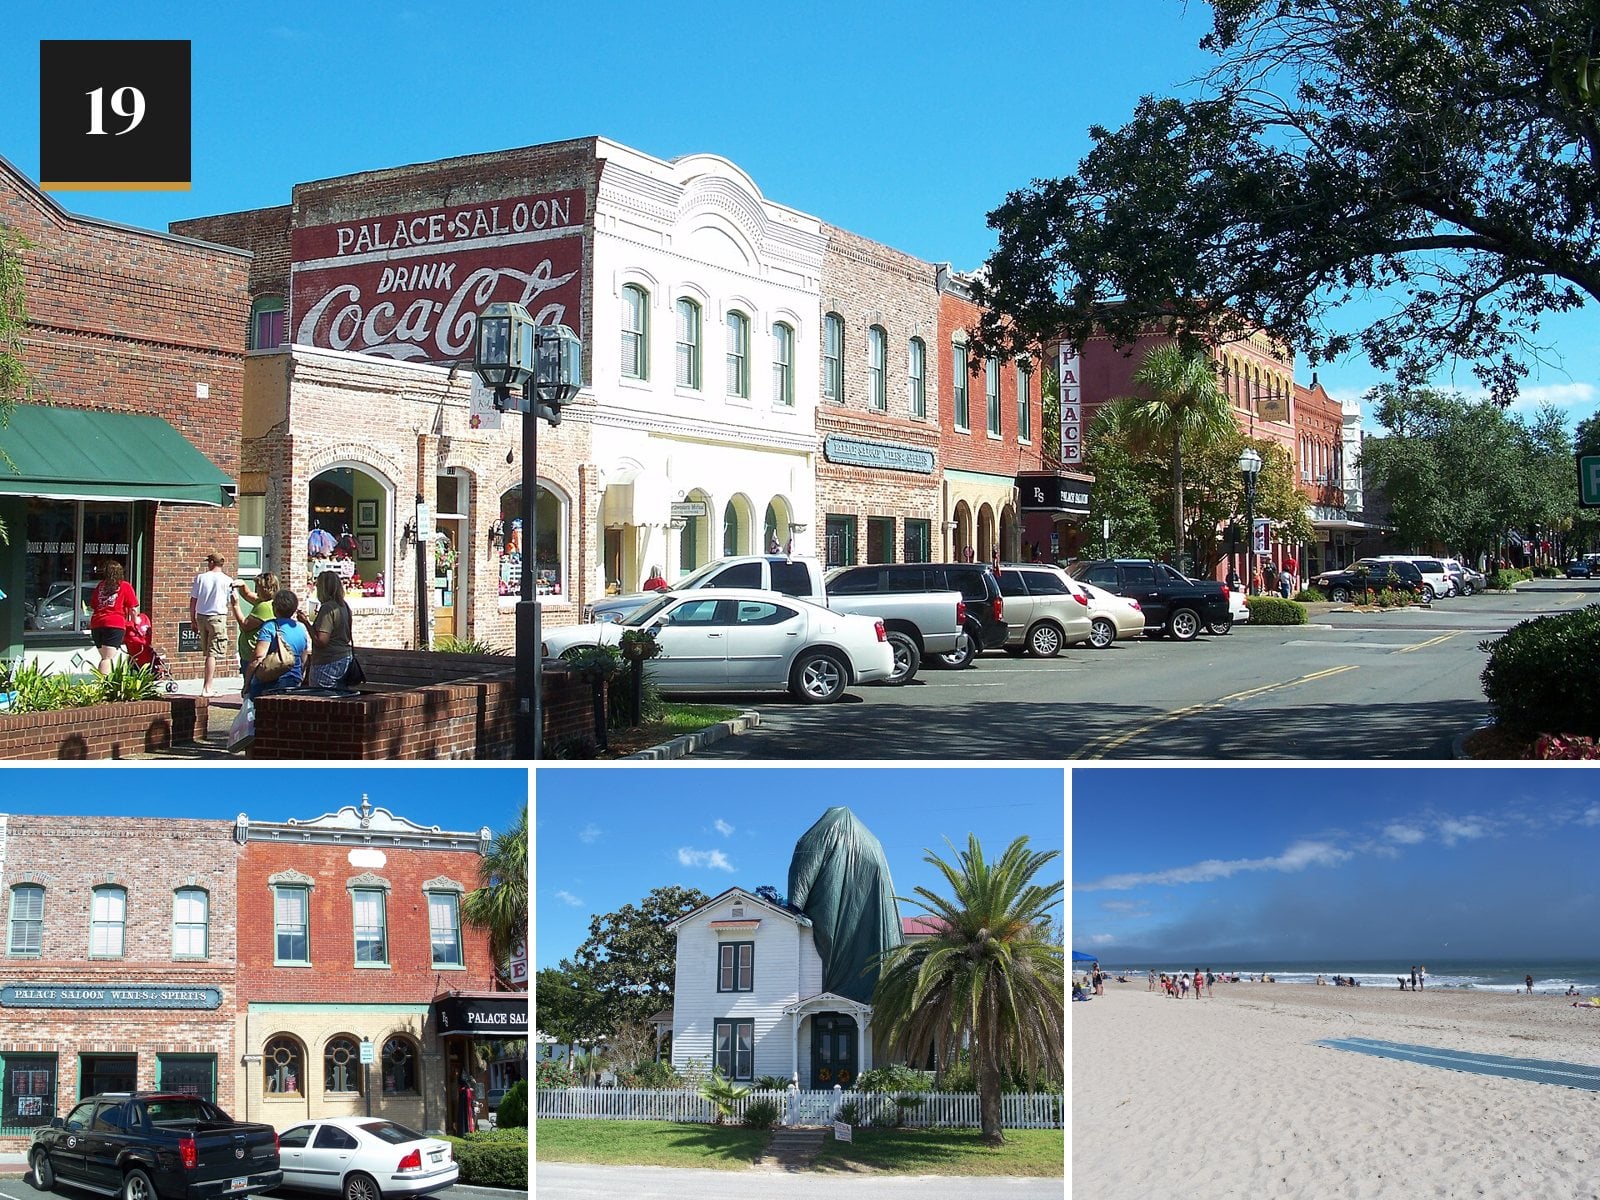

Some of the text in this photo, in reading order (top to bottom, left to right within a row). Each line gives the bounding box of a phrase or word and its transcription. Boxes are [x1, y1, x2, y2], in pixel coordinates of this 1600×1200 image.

[337, 197, 571, 255] PALACE SALOON
[376, 262, 457, 294] DRINK
[1062, 351, 1079, 459] PALACE
[14, 990, 57, 999] PALACE
[60, 990, 105, 1000] SALOON
[160, 991, 206, 1001] SPIRITS
[468, 1012, 507, 1025] PALACE
